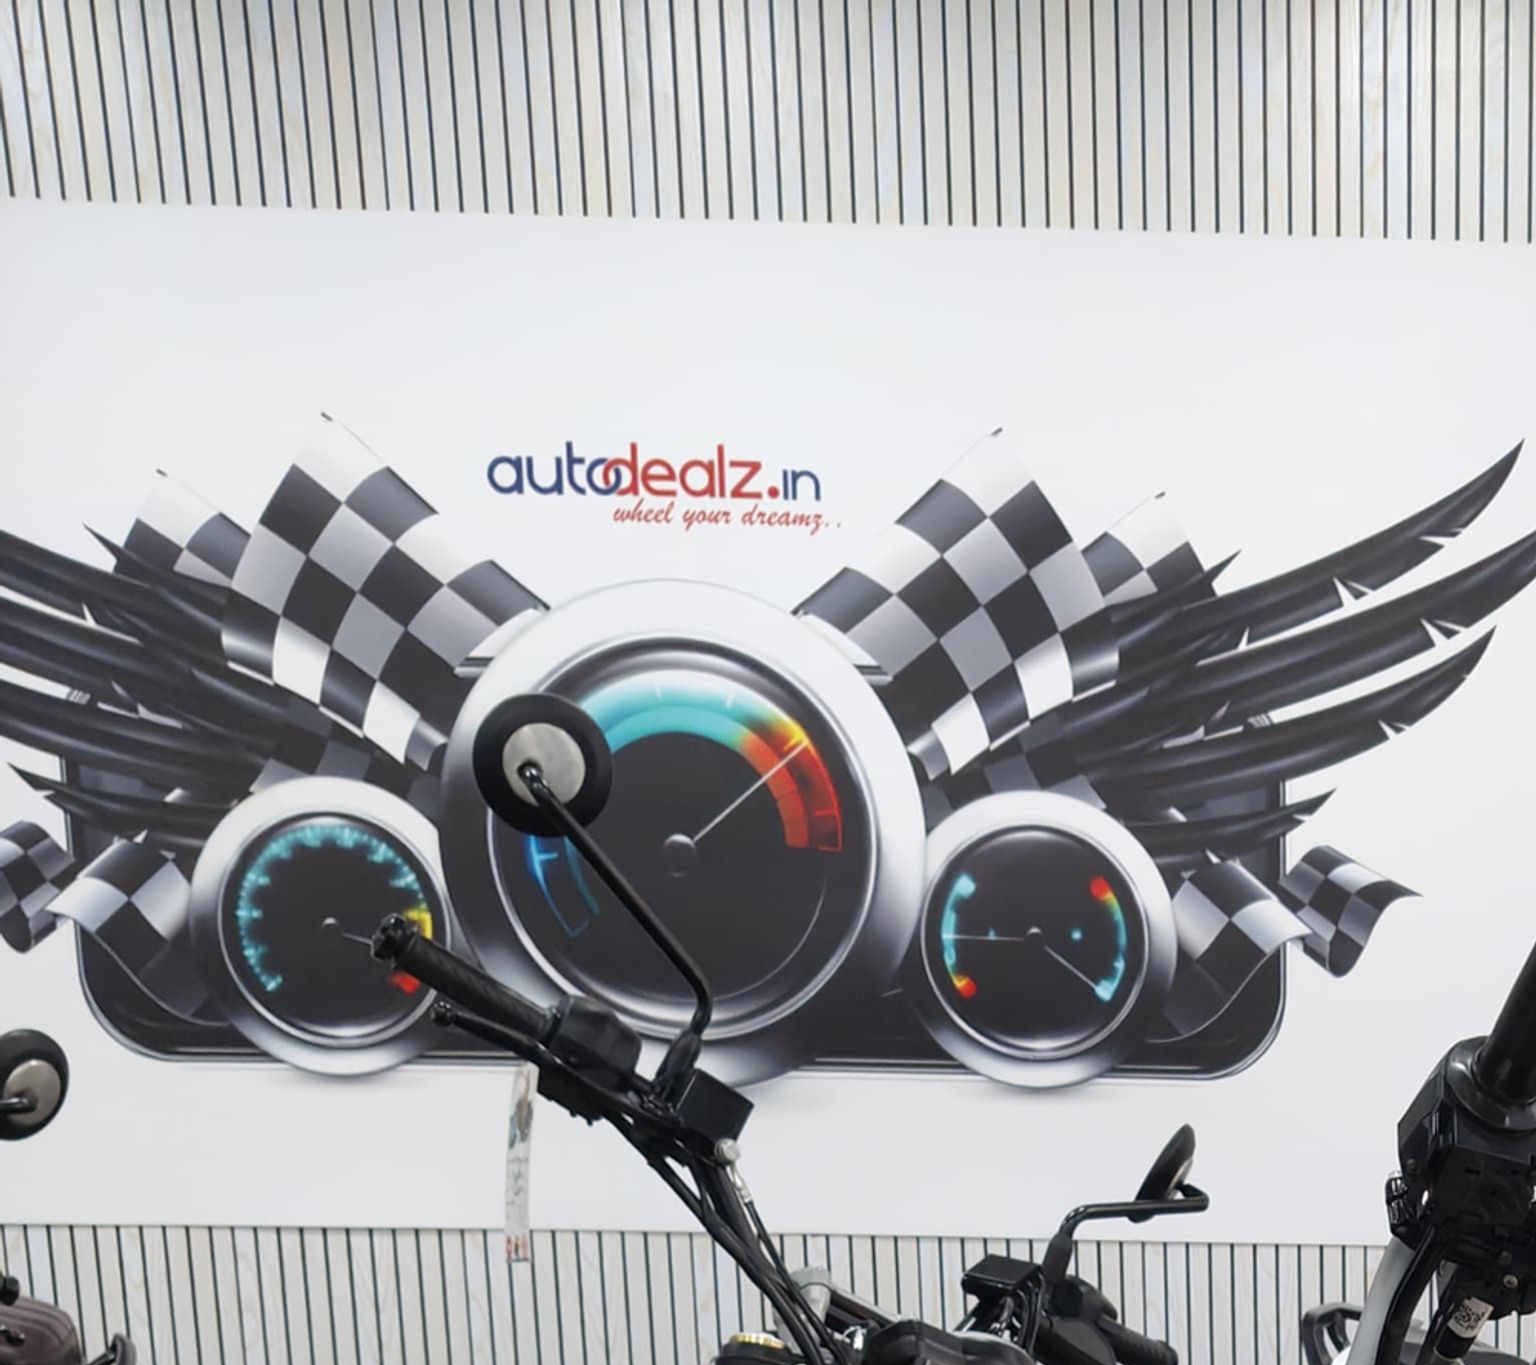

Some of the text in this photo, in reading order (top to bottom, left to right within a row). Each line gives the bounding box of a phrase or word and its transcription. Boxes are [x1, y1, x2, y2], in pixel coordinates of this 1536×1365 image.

[487, 440, 822, 501] autodealz.in
[612, 498, 676, 525] wheel
[682, 504, 732, 531] your
